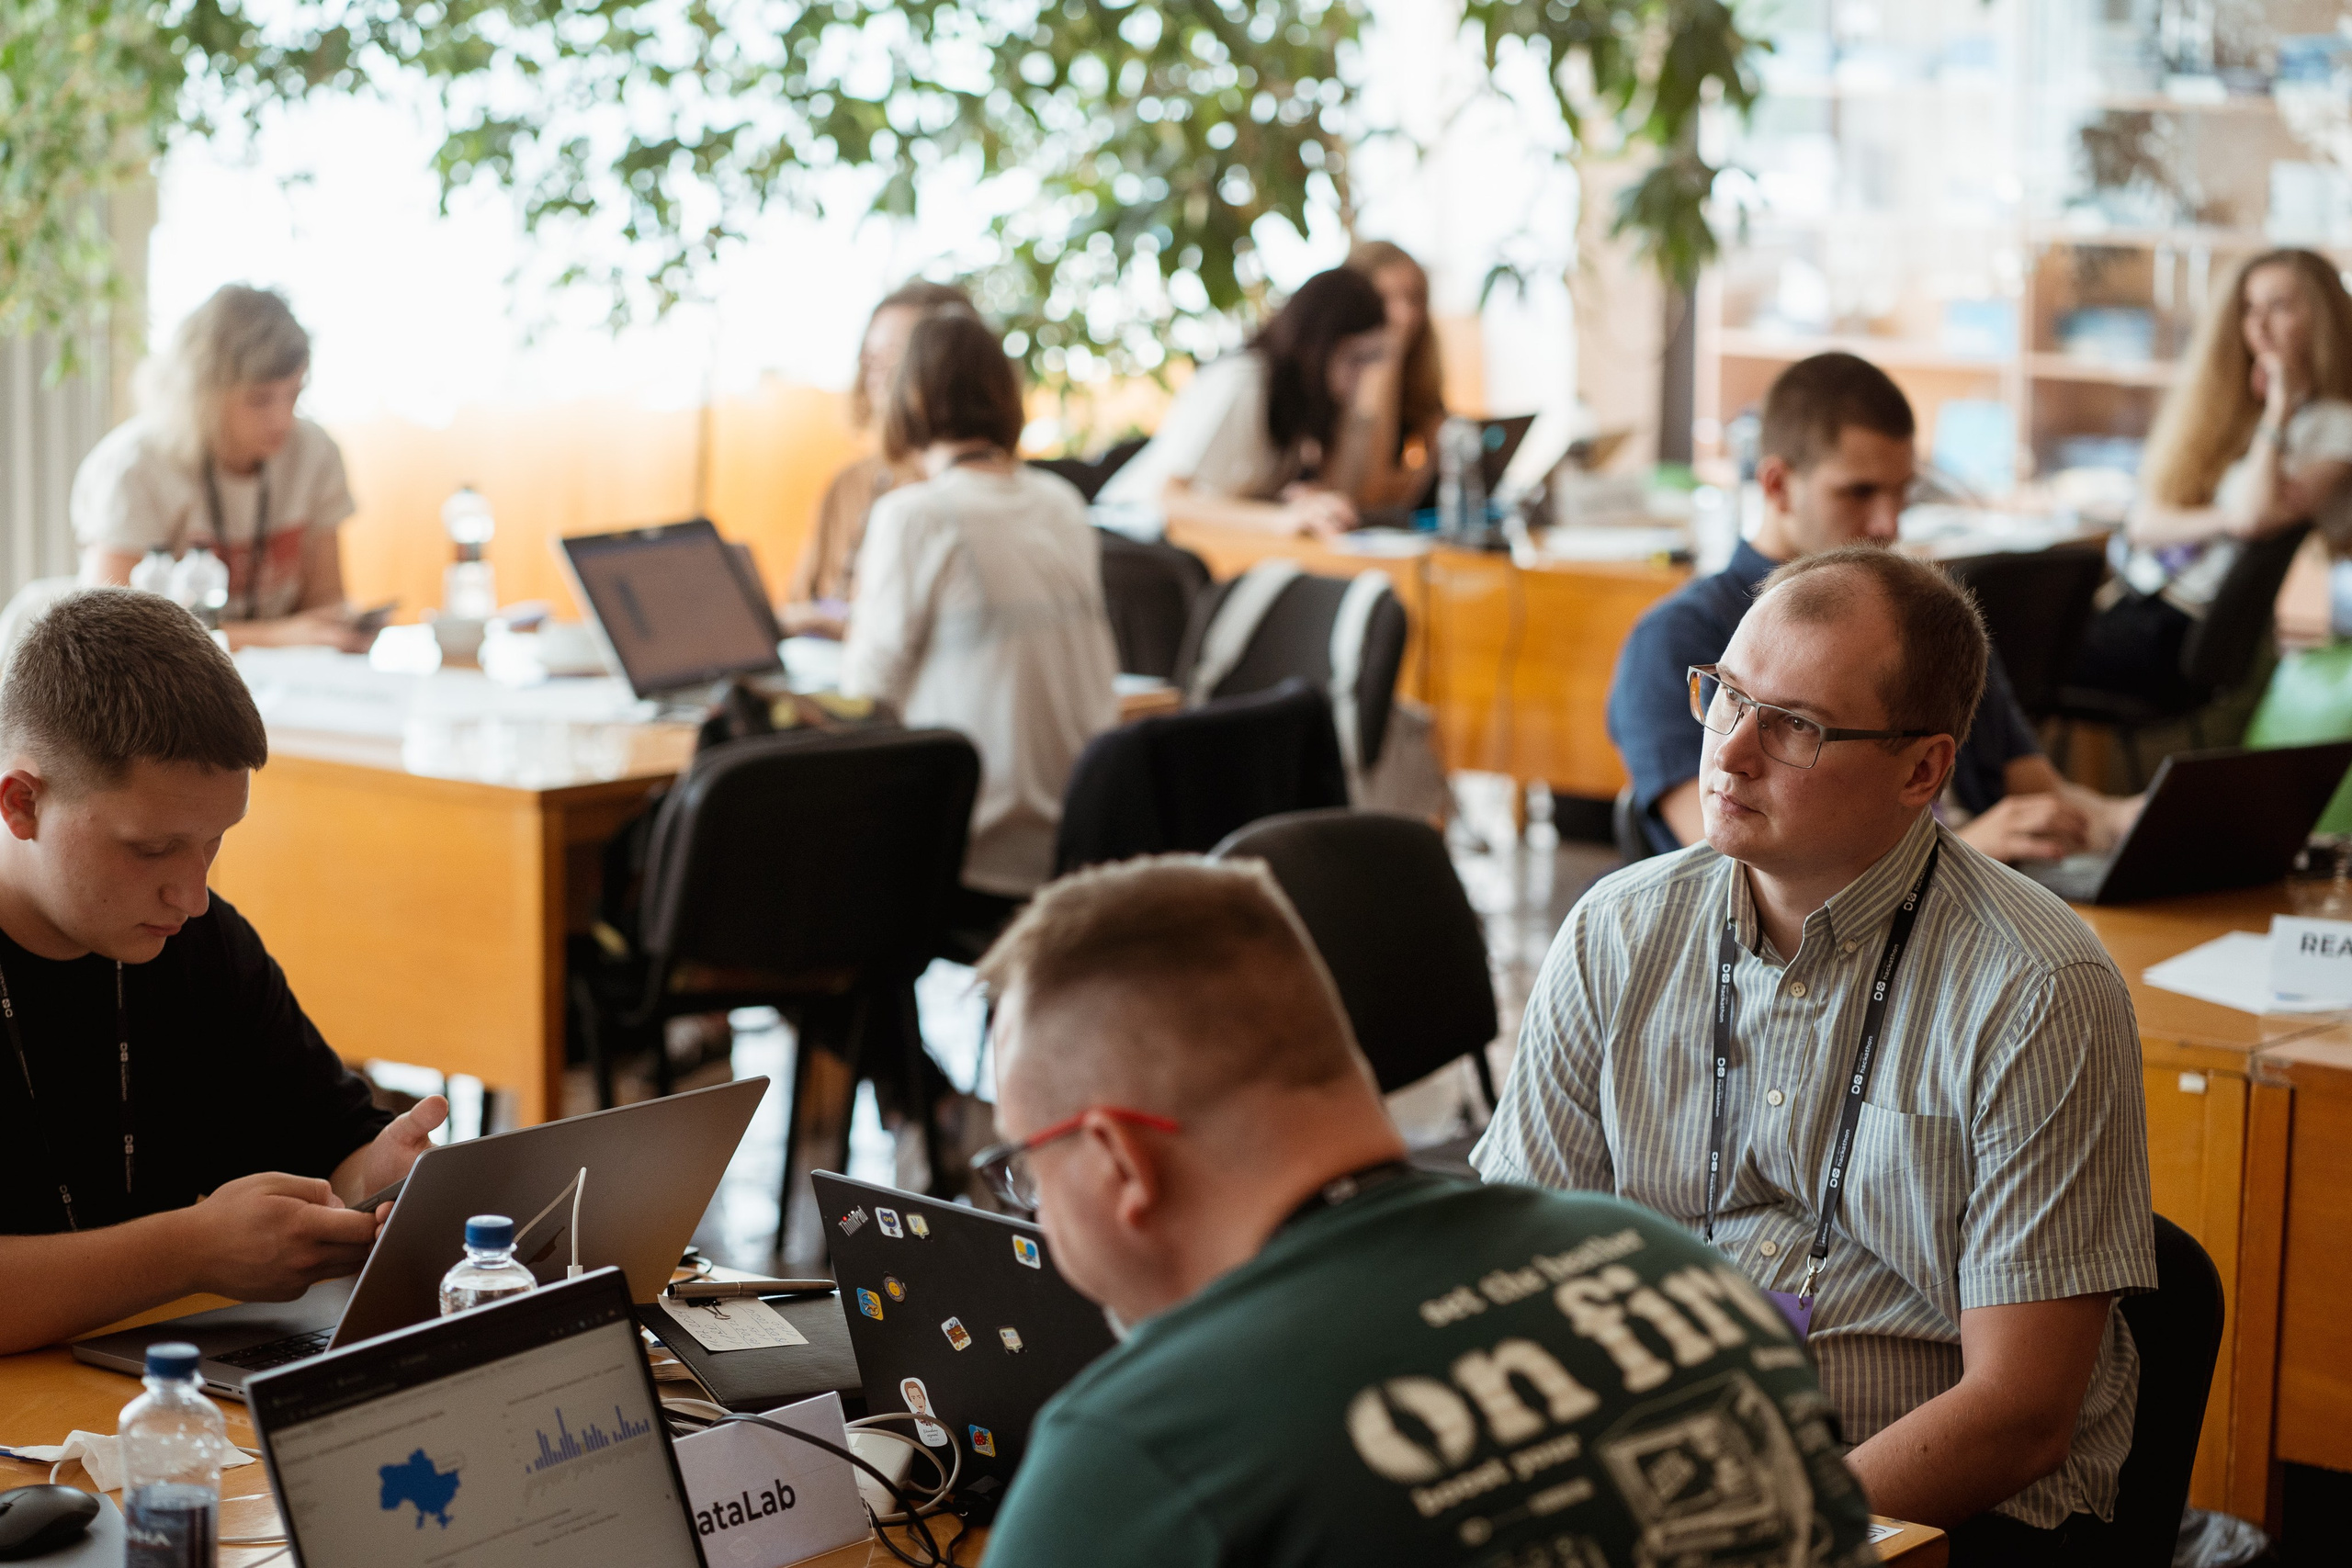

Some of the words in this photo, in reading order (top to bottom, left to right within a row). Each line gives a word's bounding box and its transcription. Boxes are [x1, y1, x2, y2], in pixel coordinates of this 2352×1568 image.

[1883, 943, 1899, 980] hackathon
[1860, 1035, 1873, 1074] hackathon
[1838, 1128, 1850, 1168] hackathon
[838, 1204, 868, 1236] ThinkPad
[1346, 1337, 1601, 1482] on
